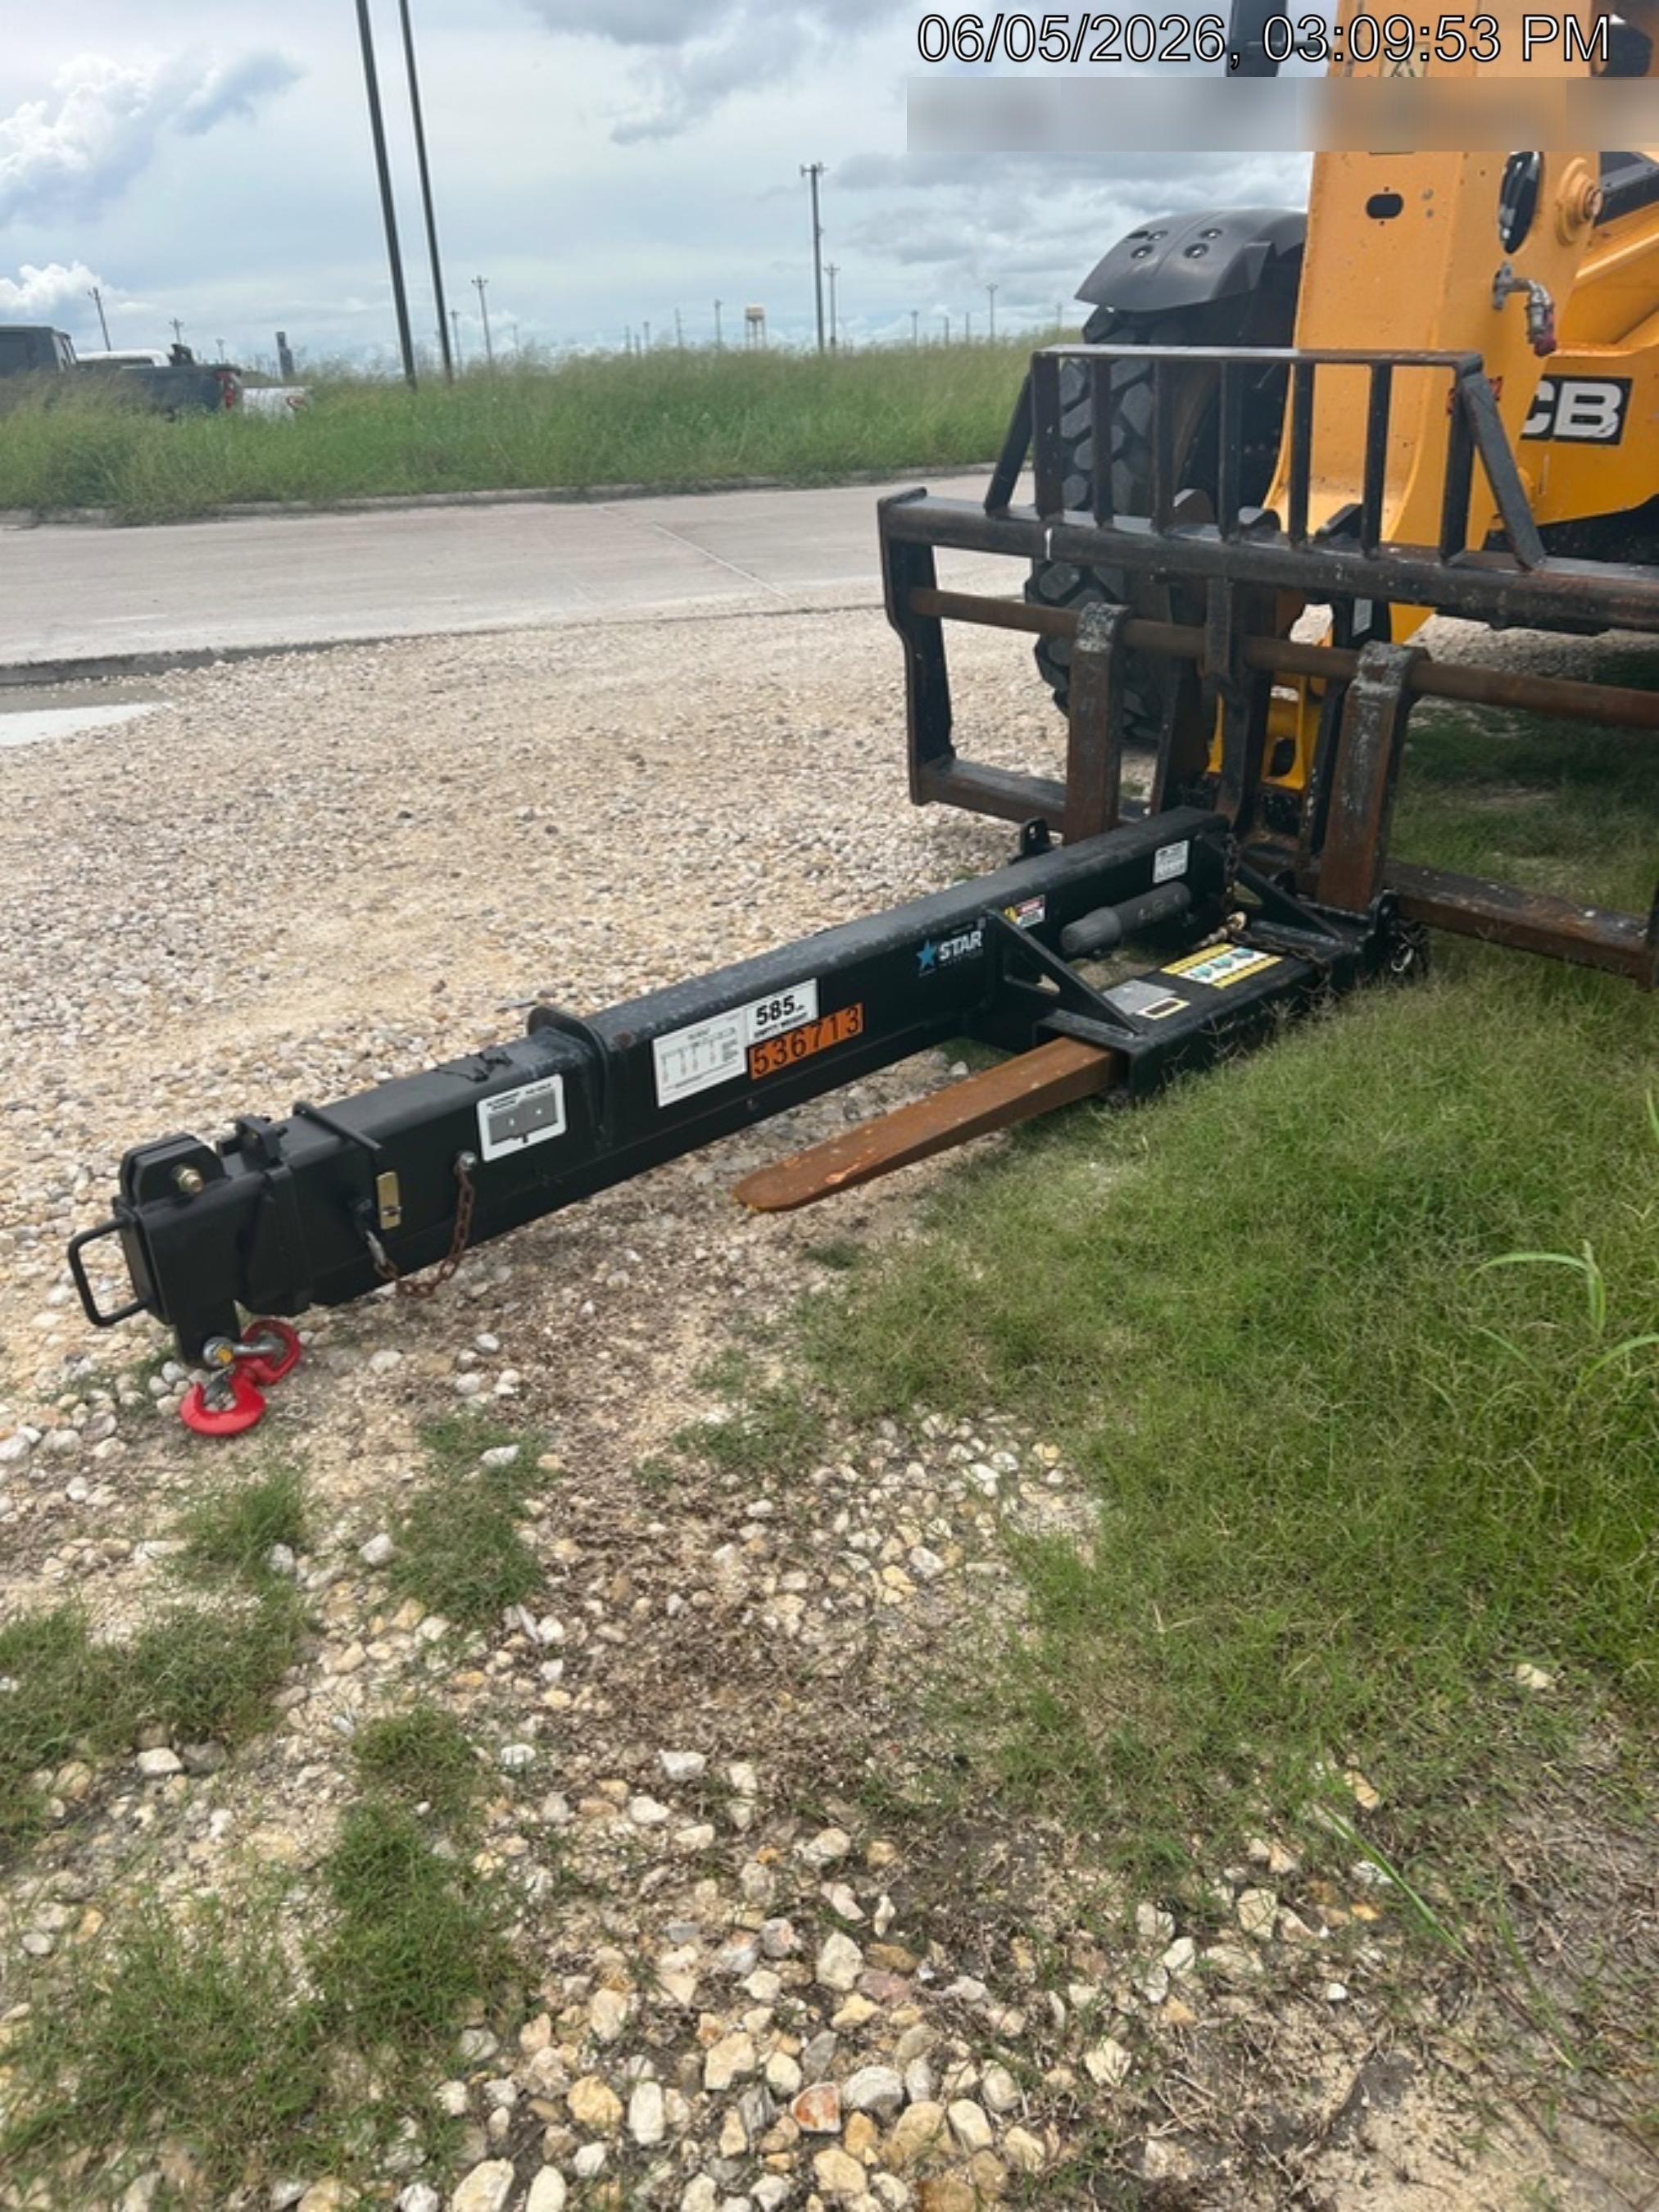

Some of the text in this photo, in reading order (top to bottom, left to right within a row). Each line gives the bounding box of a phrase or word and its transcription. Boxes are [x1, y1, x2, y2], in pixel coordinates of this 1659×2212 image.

[1521, 379, 1623, 439] CB
[938, 930, 983, 961] STAR
[756, 994, 795, 1026] 585
[753, 1006, 859, 1075] 536713
